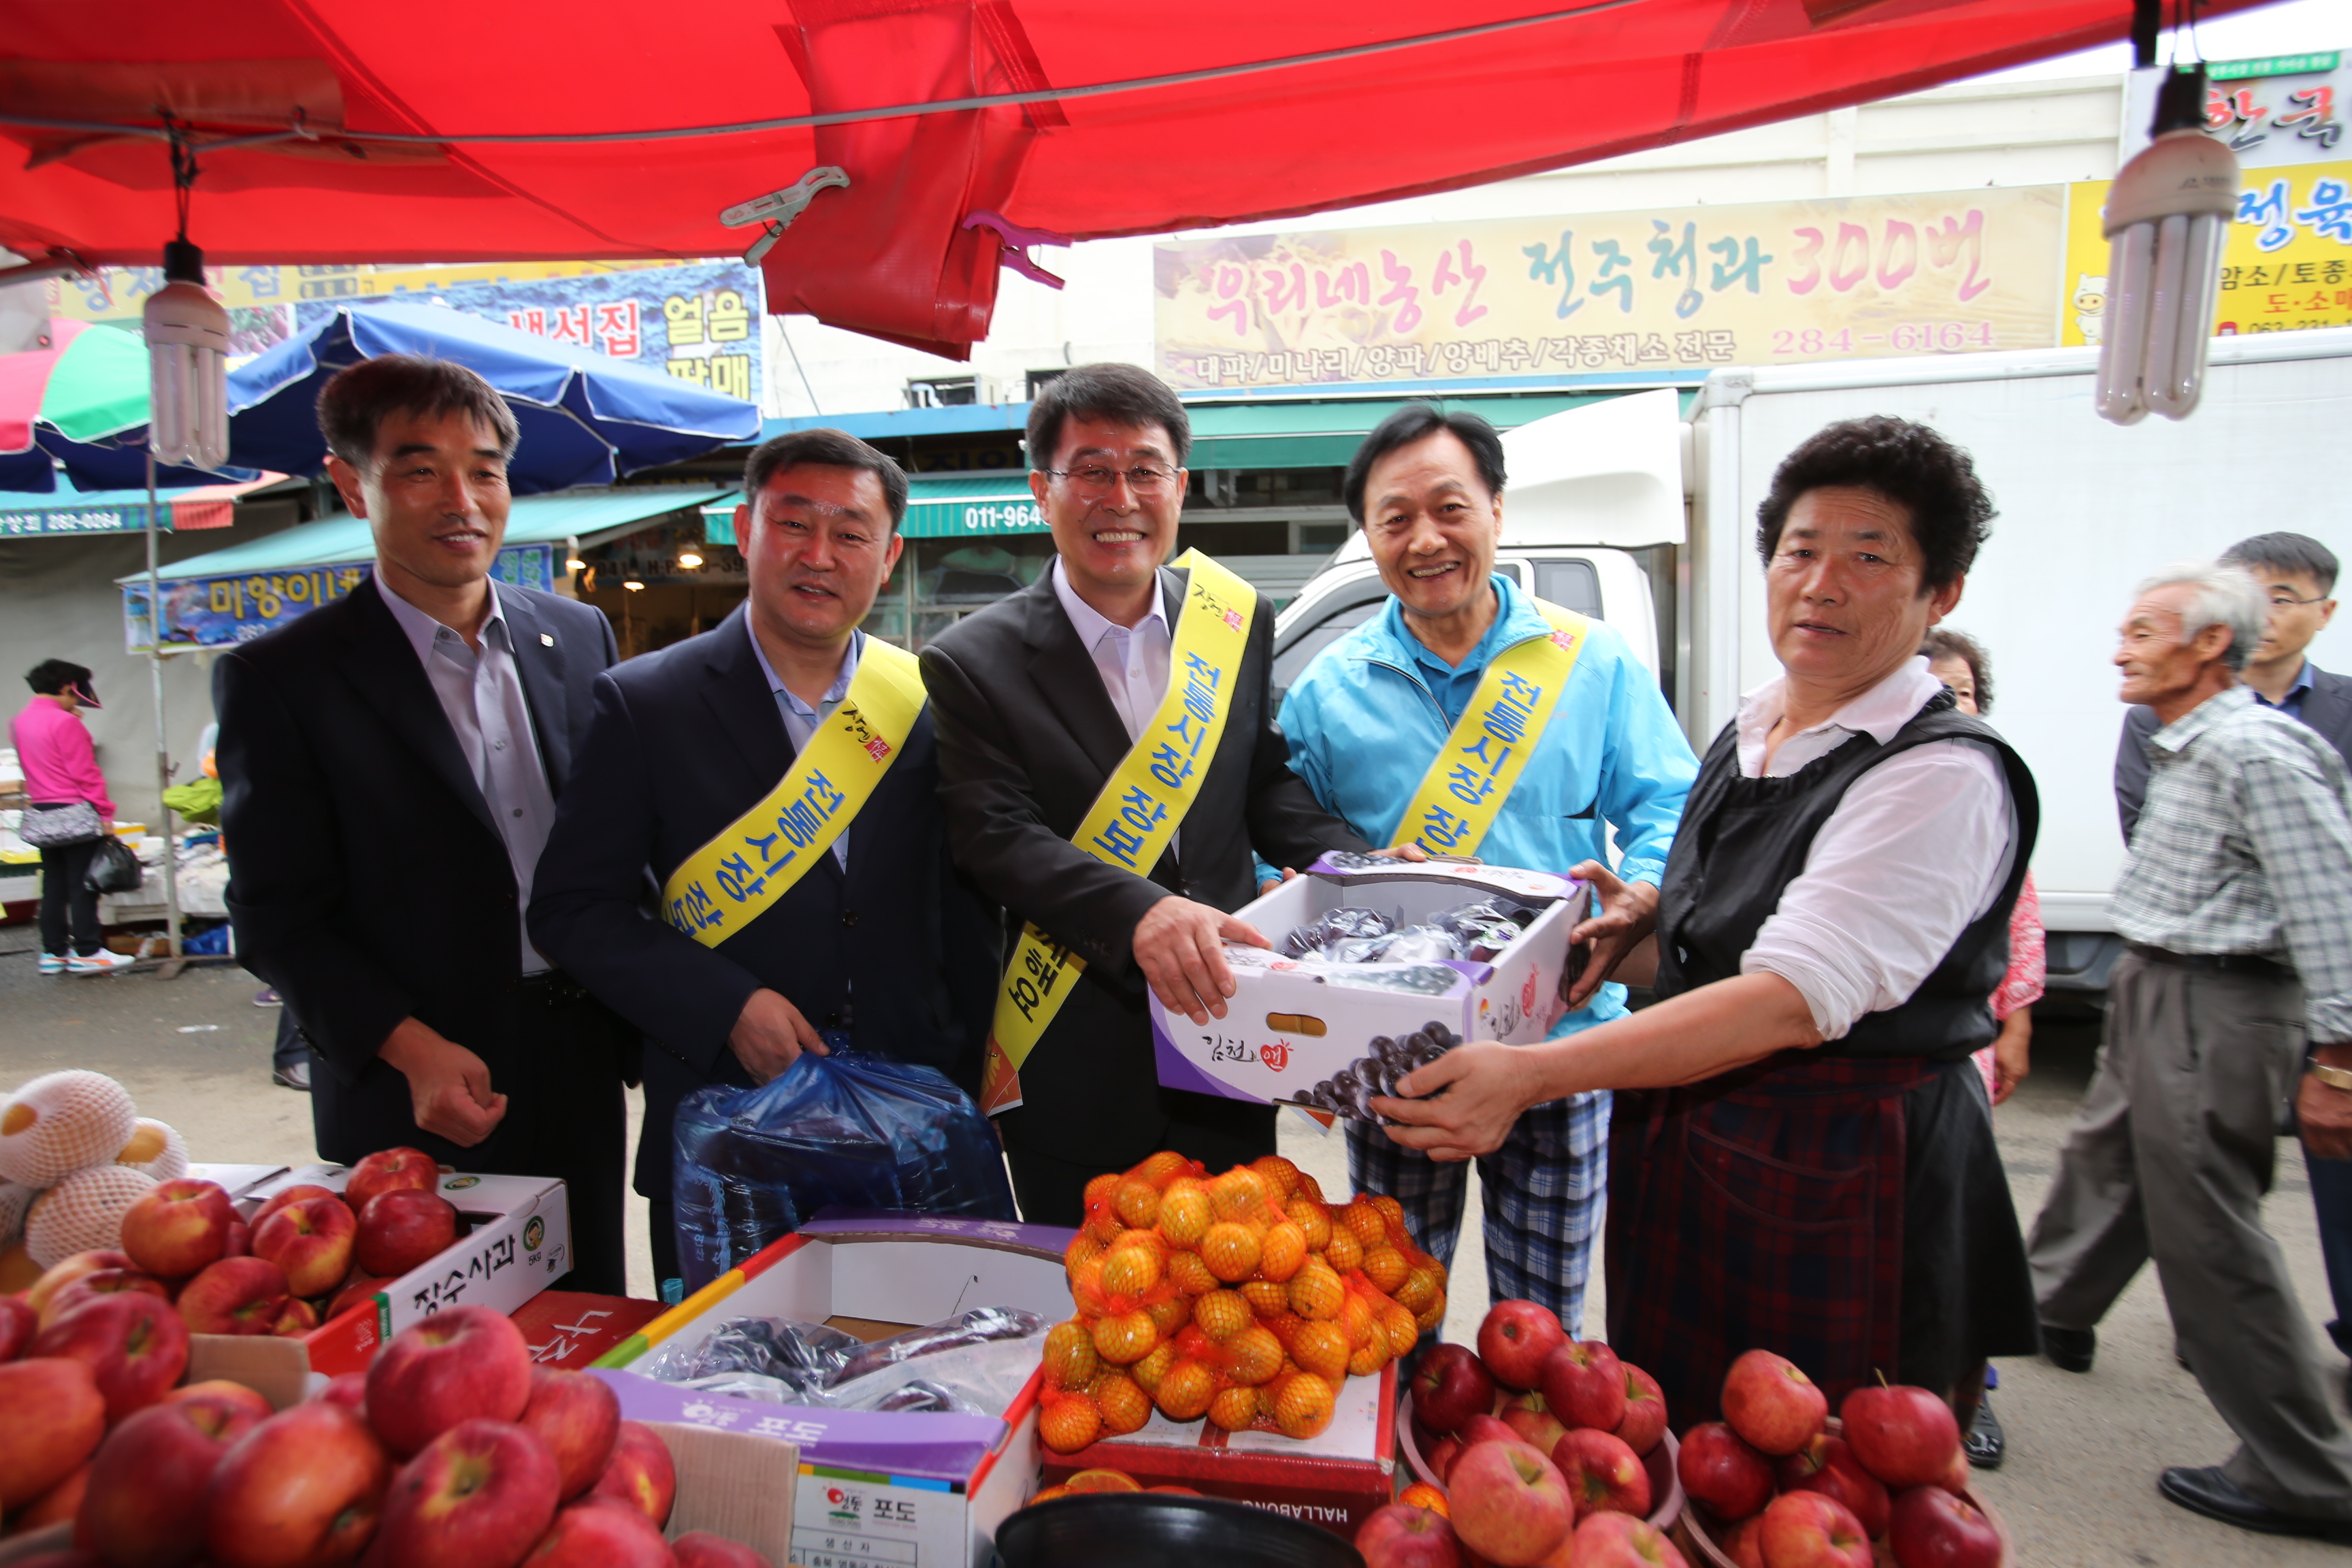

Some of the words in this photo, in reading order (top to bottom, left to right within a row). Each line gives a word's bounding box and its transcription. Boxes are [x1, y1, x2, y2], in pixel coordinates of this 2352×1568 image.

[1207, 239, 1487, 336] 우리네농산
[1522, 218, 1772, 320] 전주청과
[1787, 210, 1991, 301] 300번
[2221, 260, 2352, 291] 암소/토종
[664, 291, 749, 345] 얼음
[1674, 330, 1736, 363] 전문
[1772, 321, 1994, 355] 284-6164
[966, 505, 1050, 529] 011-964
[1149, 650, 1220, 790] 전통시장
[1448, 670, 1543, 806] 전통시장
[715, 768, 847, 903] 전통시장
[1087, 785, 1168, 868] 장보
[666, 880, 725, 938] 장보
[414, 1233, 516, 1316] 장수사과
[529, 1252, 542, 1266] 5kg
[749, 1416, 828, 1442] 포도
[874, 1499, 916, 1523] 포도
